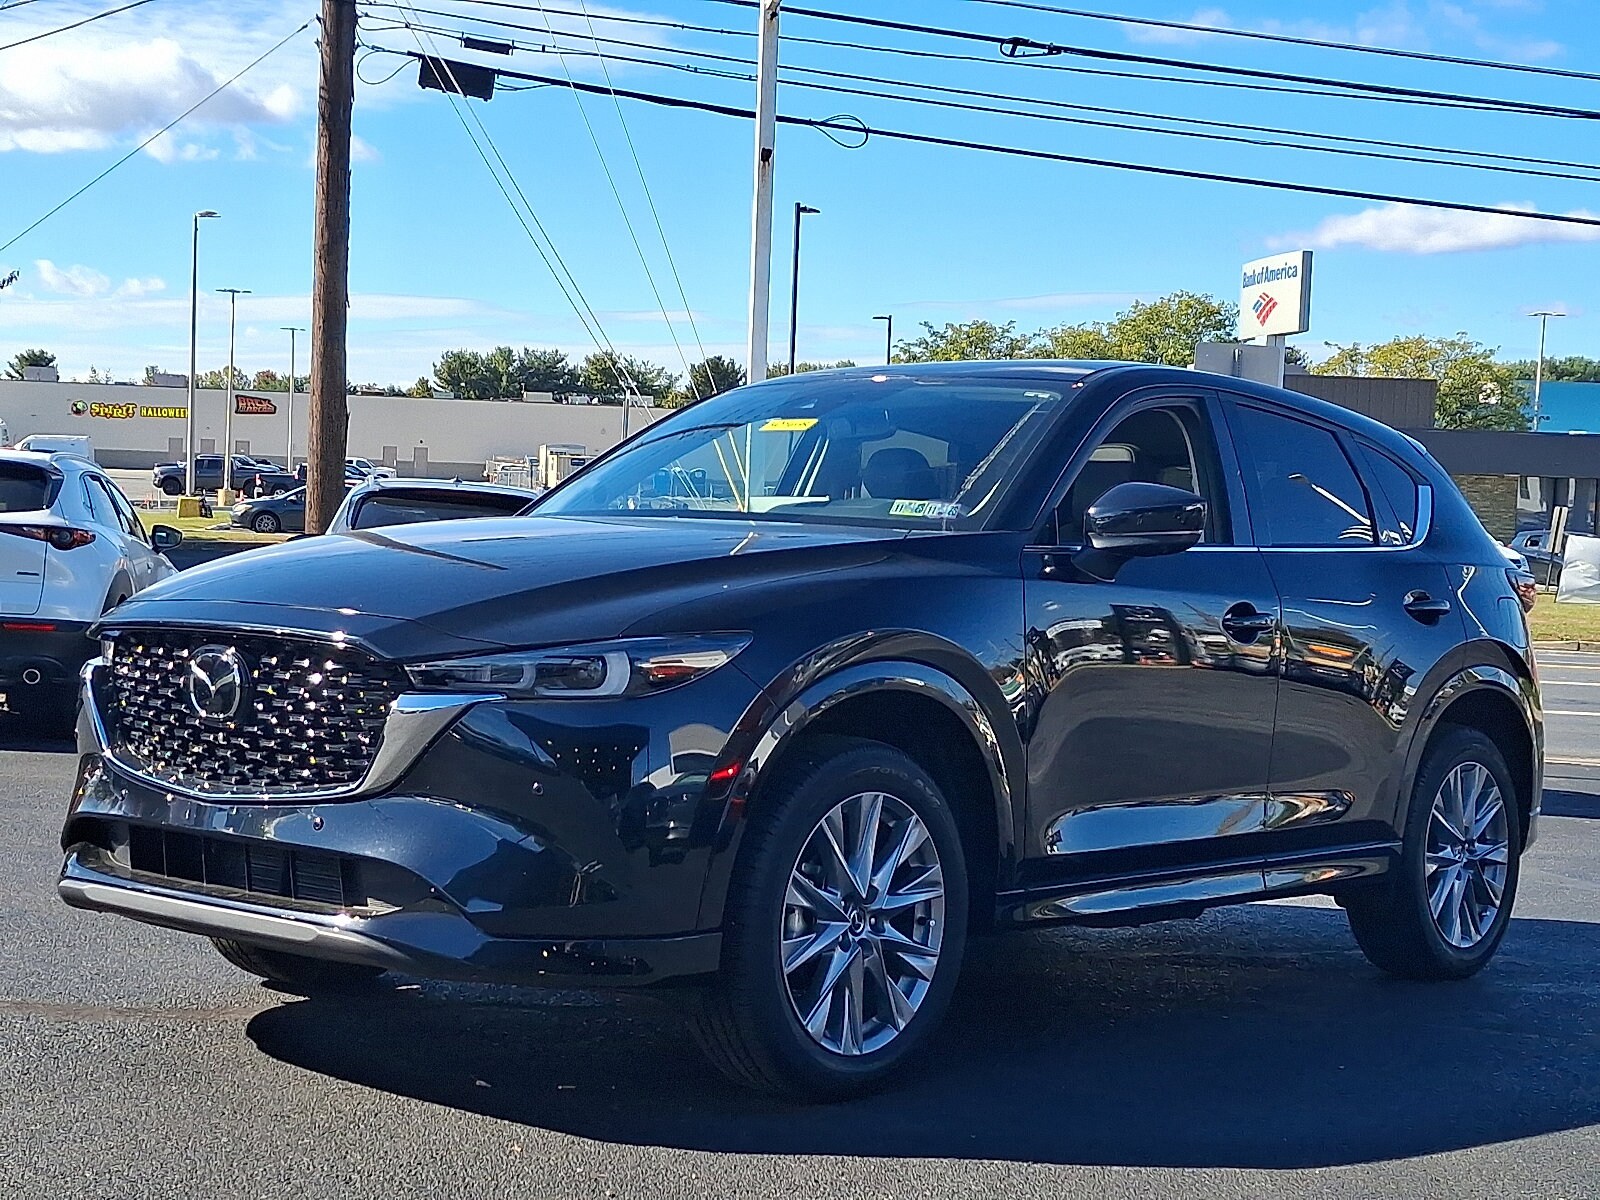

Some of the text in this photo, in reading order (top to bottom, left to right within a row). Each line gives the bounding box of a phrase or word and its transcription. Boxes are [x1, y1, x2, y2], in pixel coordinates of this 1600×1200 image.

[1243, 262, 1298, 288] Bank of America
[90, 402, 137, 419] SPIRIT
